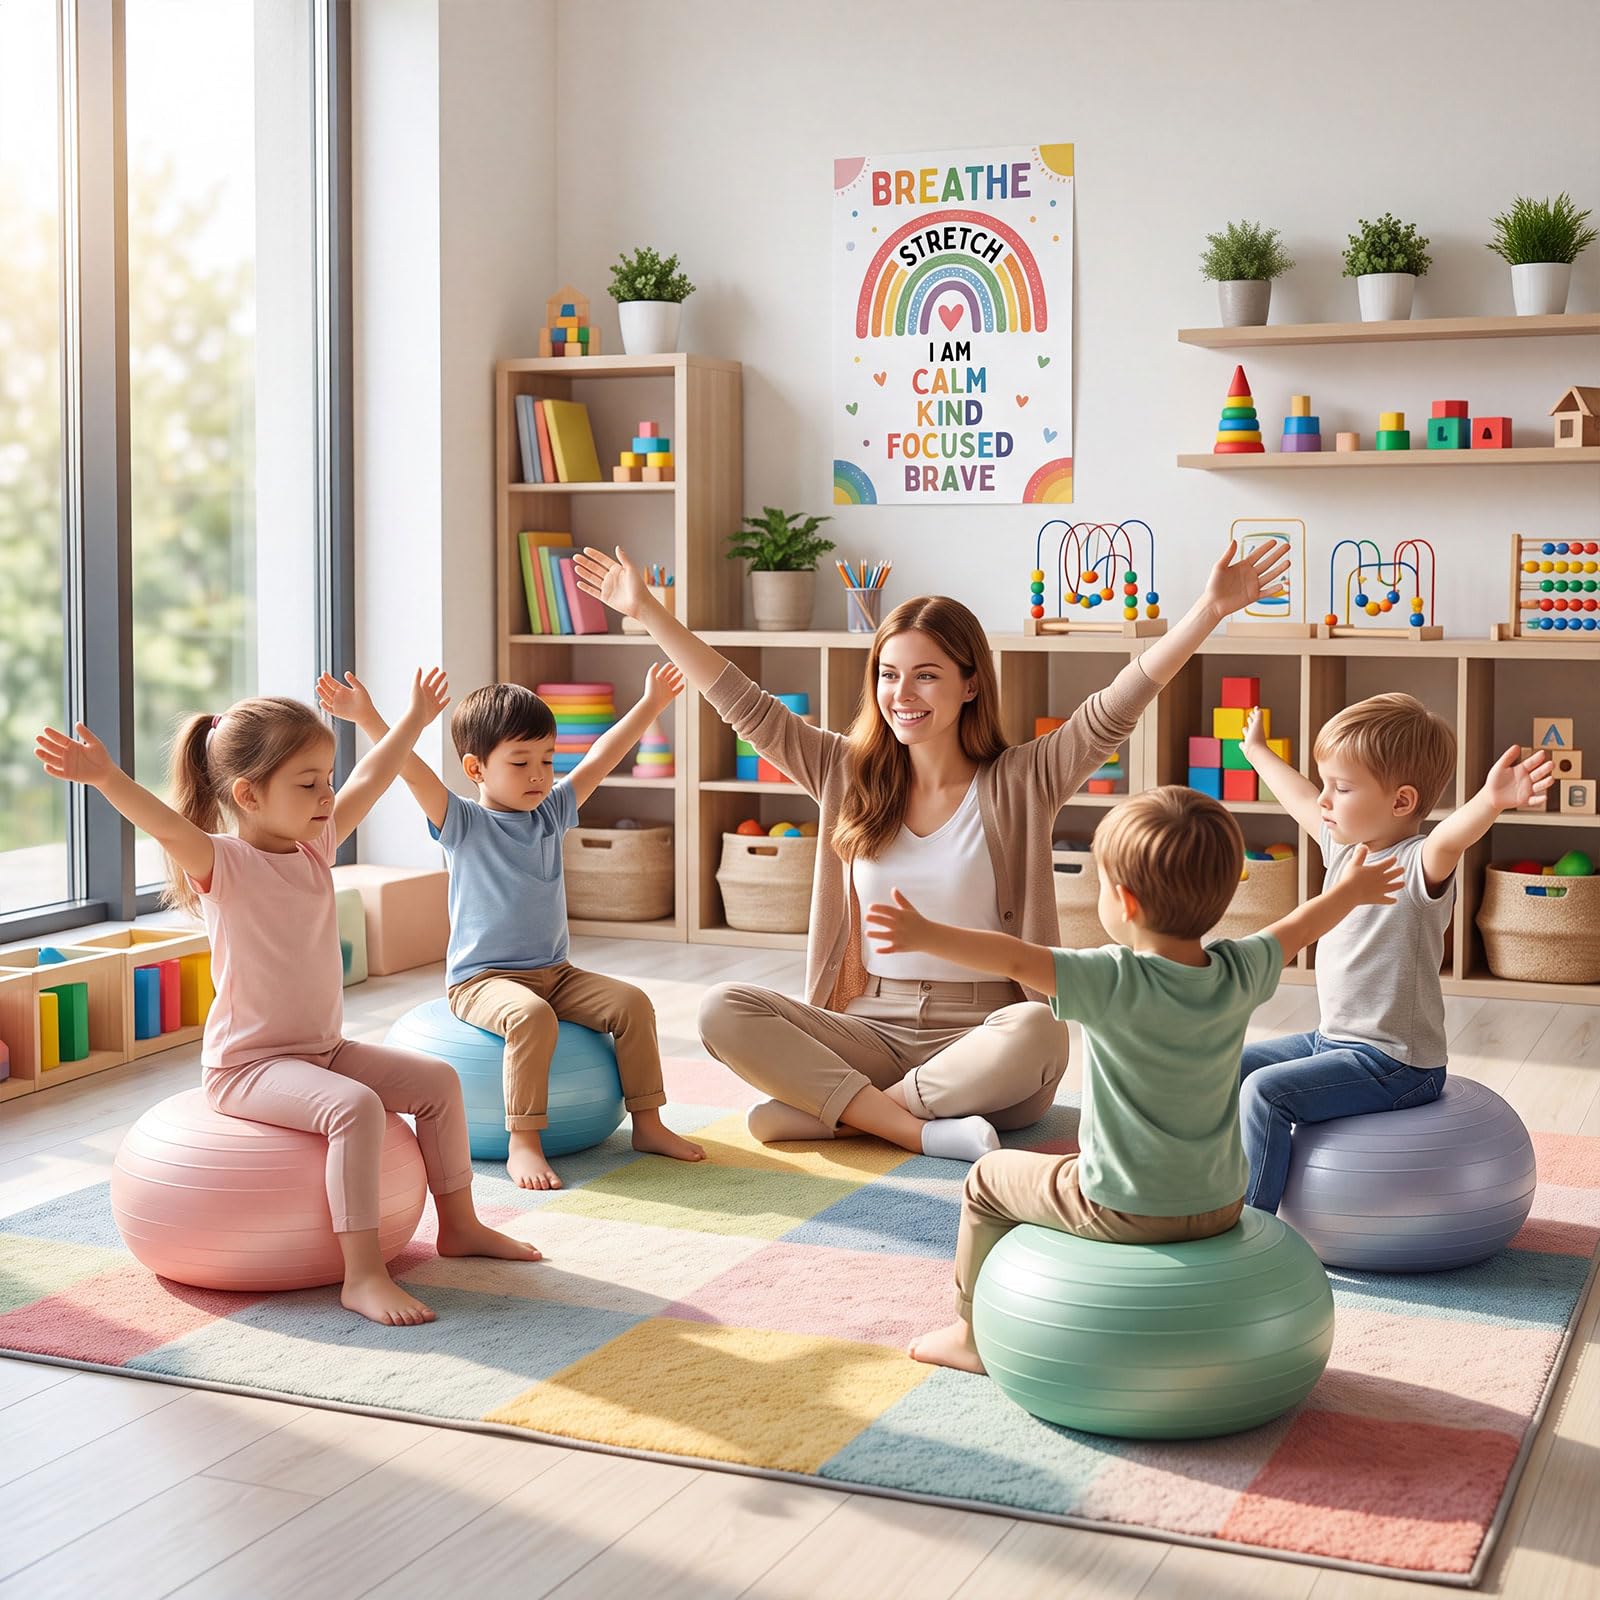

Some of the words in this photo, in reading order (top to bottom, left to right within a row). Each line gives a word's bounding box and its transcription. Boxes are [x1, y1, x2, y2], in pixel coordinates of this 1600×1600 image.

[872, 163, 1031, 206] BREATHE
[899, 227, 1004, 267] STRETCH
[929, 342, 934, 362] I
[940, 341, 971, 362] AM
[912, 367, 987, 395] CALM
[917, 400, 983, 427] KIND
[887, 432, 1014, 459] FOCUSED
[905, 465, 995, 491] BRAVE
